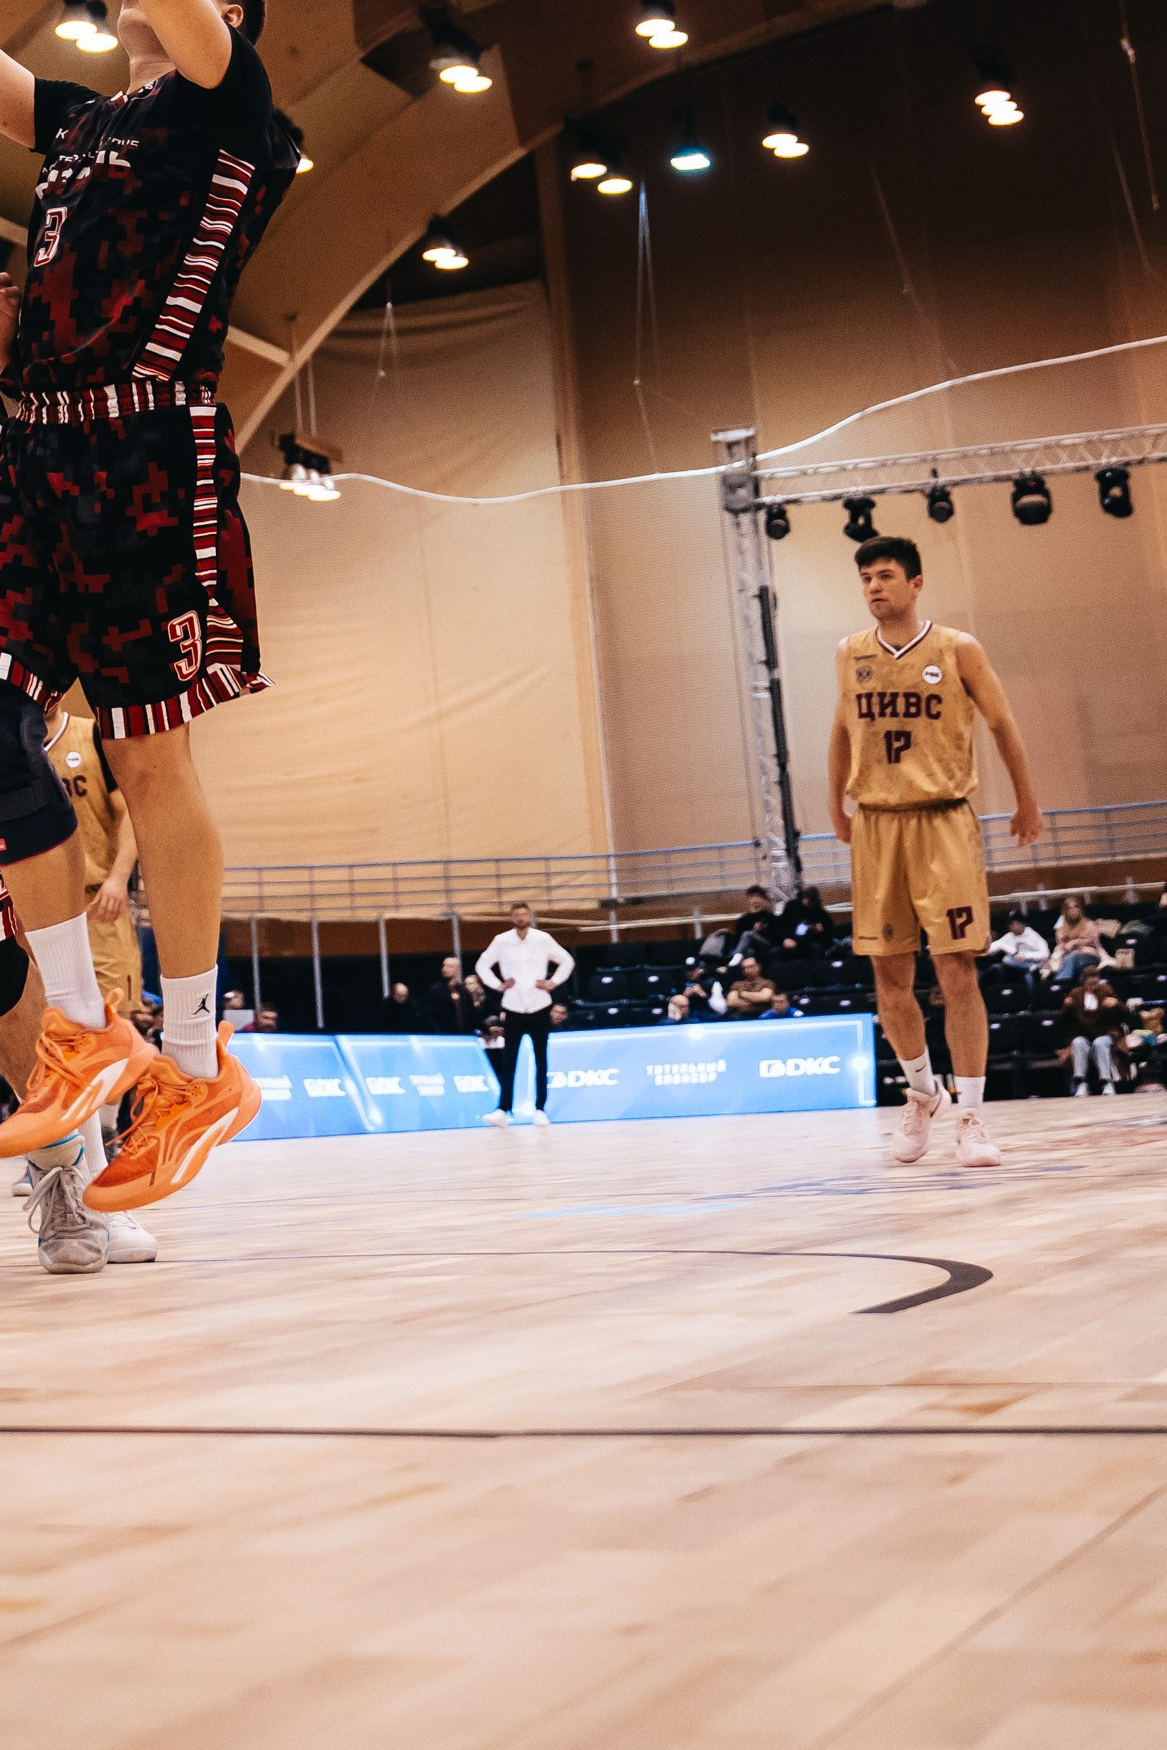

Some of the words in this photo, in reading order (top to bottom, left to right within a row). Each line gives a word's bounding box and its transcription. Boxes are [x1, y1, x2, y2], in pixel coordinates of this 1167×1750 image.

[34, 207, 68, 267] 3
[167, 610, 203, 682] 3
[855, 691, 944, 722] ЦИВС
